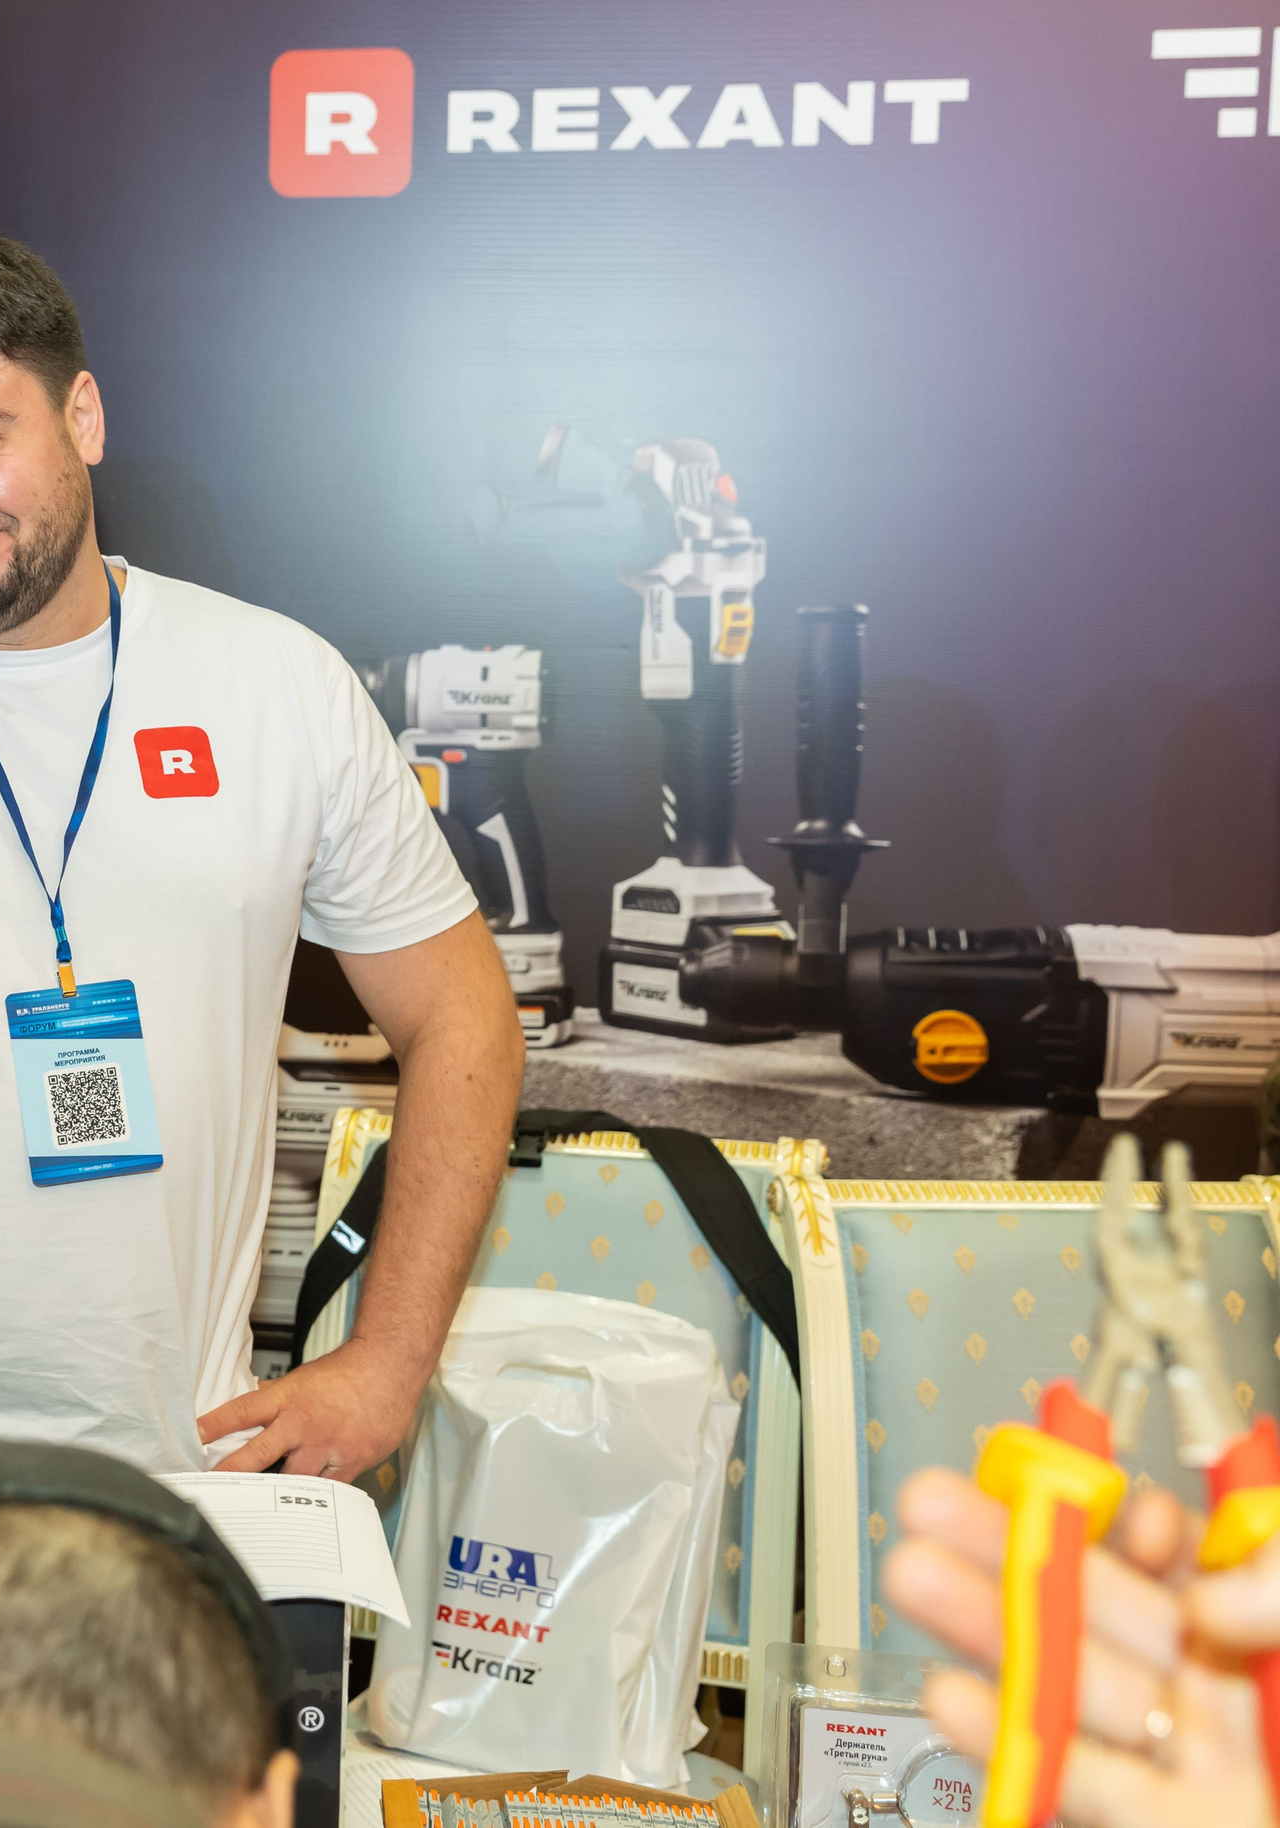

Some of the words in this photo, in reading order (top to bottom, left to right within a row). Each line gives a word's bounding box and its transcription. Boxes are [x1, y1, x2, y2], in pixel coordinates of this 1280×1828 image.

[305, 92, 379, 155] R
[446, 78, 970, 153] REXANT
[460, 690, 512, 706] Kranz
[160, 749, 197, 775] R
[31, 1003, 70, 1012] УРАЛЭНЕРГО
[19, 1022, 56, 1034] ФОРУМ
[54, 1054, 106, 1067] МЕРОПРИЯТИЯ
[57, 1047, 100, 1058] ПРОГРАММА
[279, 1495, 328, 1508] SDS
[448, 1535, 558, 1591] URAL
[443, 1571, 556, 1609] ЭНЕРГО
[436, 1604, 551, 1643] REXANT
[452, 1646, 536, 1685] Kranz
[826, 1723, 887, 1737] REXANT
[835, 1738, 886, 1752] Держатель
[823, 1748, 859, 1760] «Третья
[861, 1750, 888, 1763] рука»
[932, 1777, 973, 1795] ЛУПА
